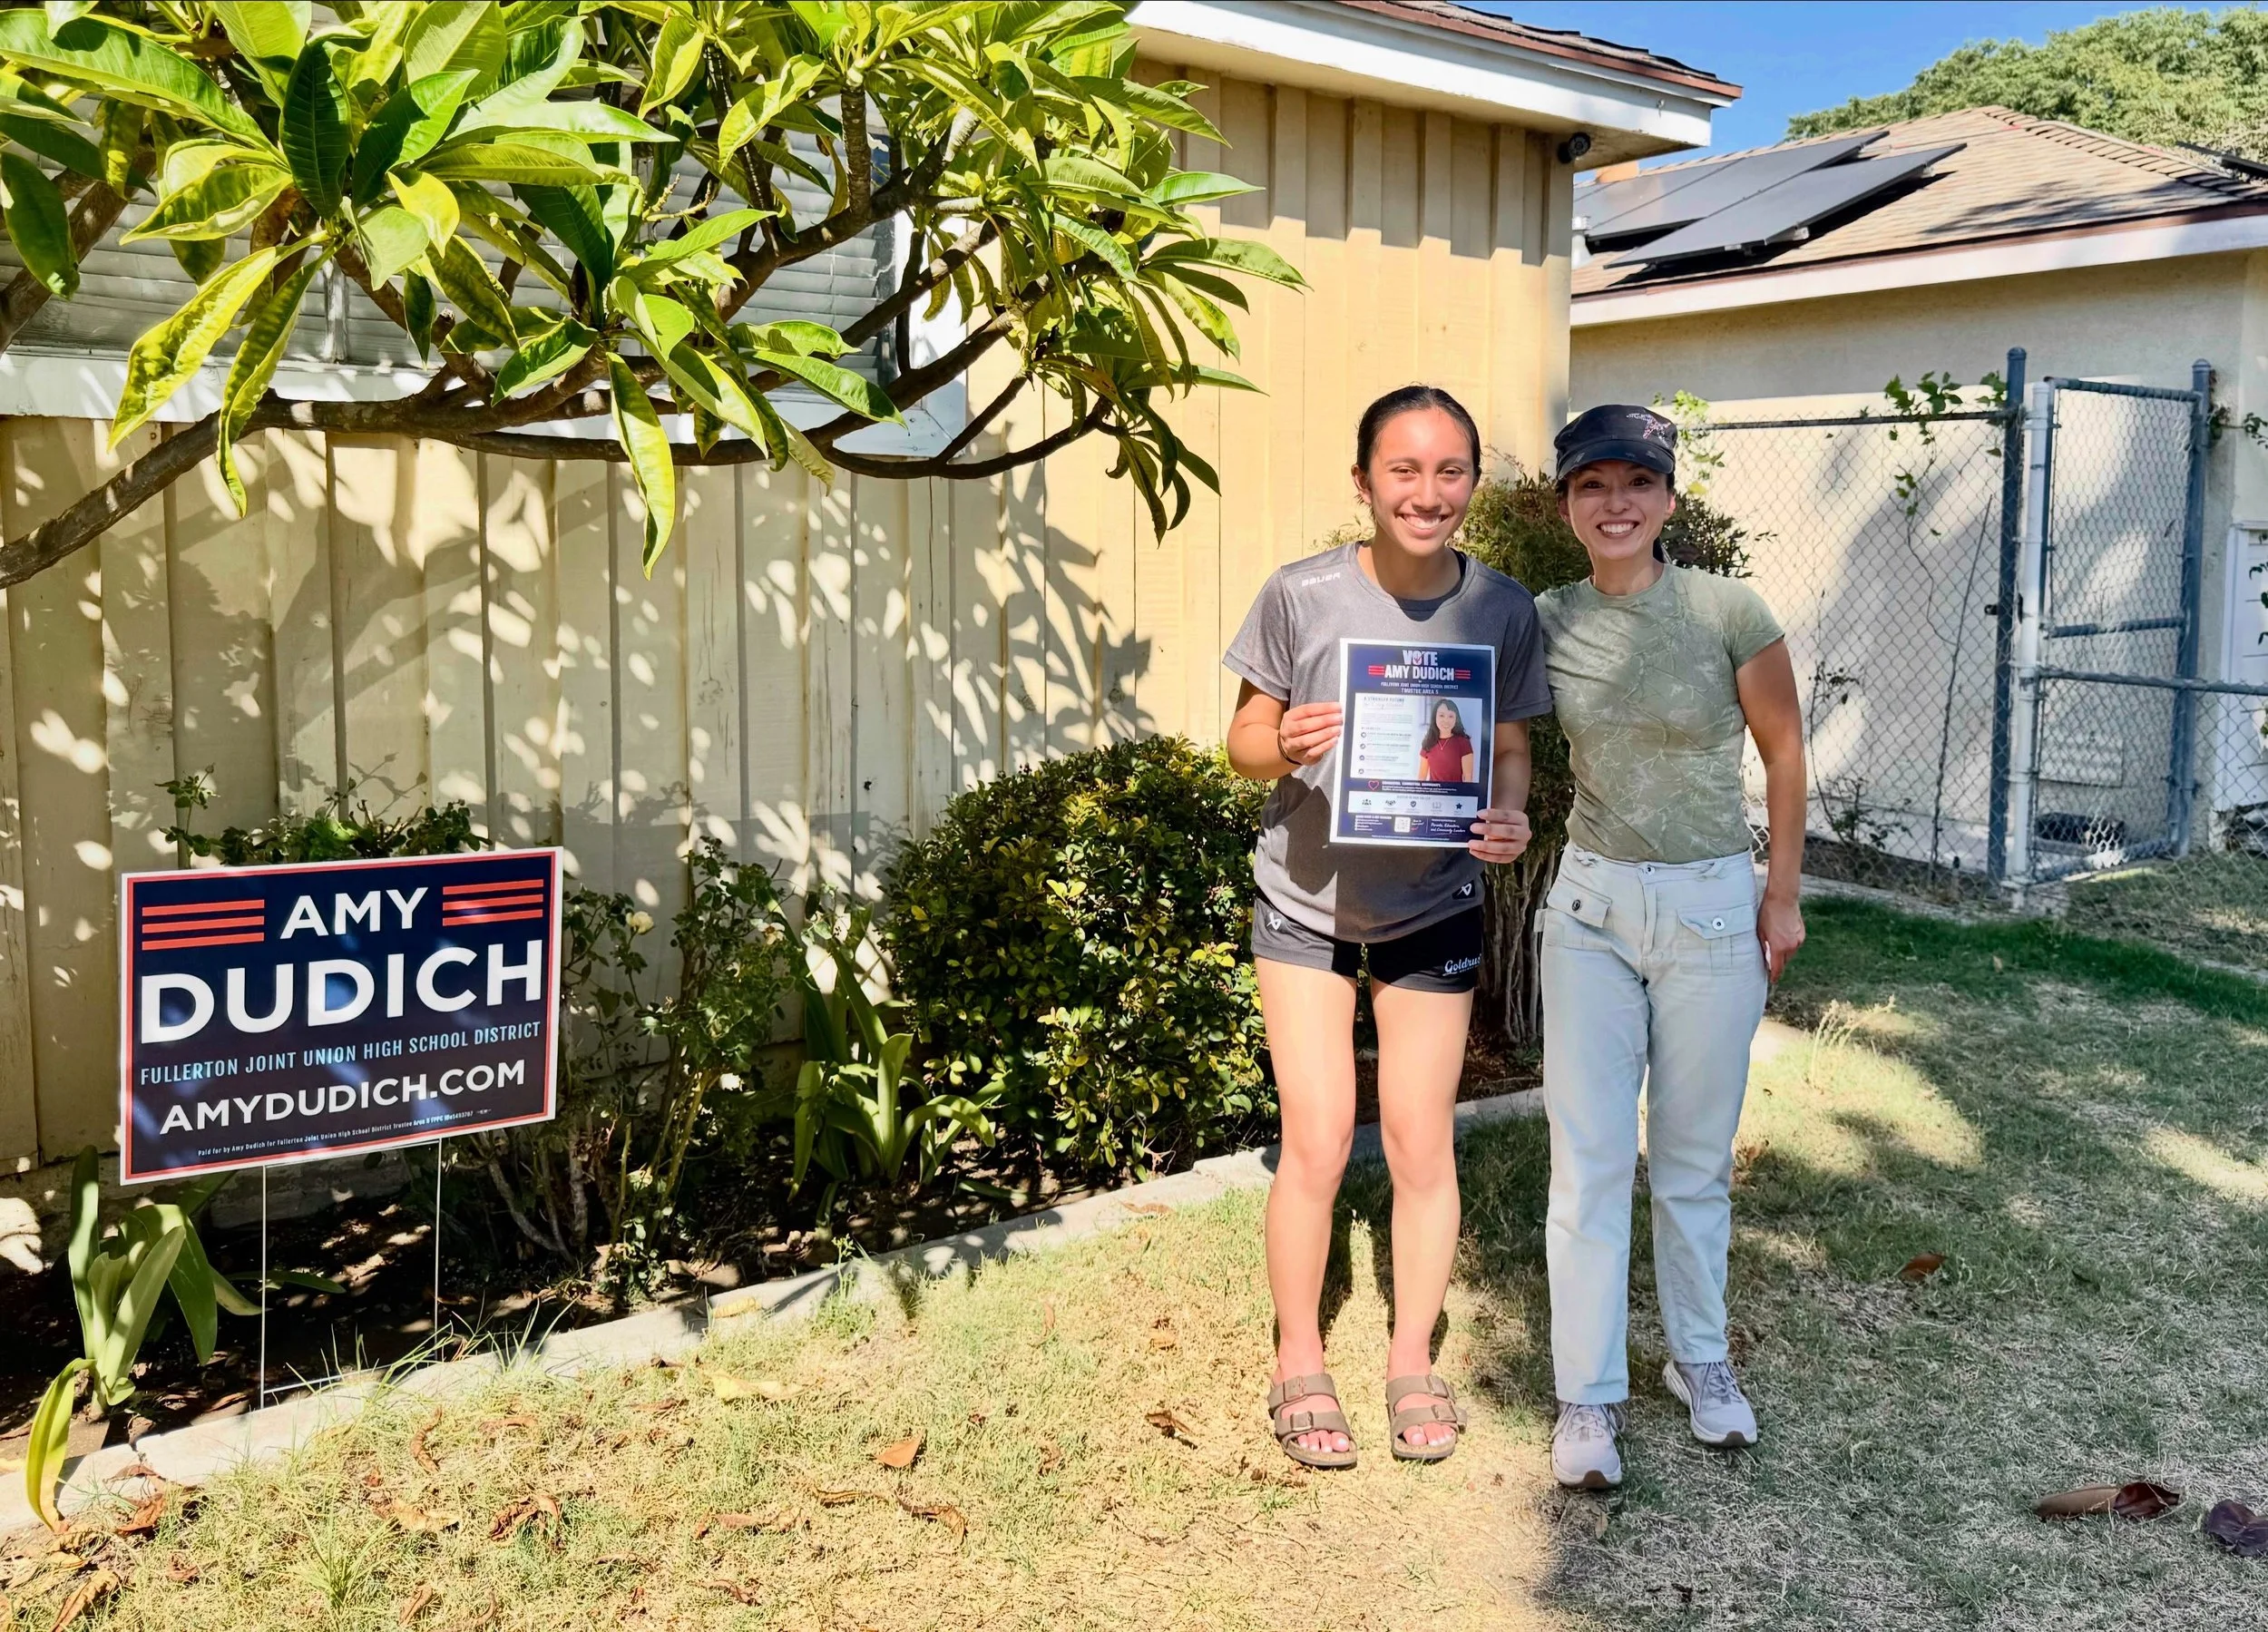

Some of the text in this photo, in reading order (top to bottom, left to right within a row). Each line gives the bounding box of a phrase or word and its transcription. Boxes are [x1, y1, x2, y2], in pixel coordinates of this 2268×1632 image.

[1384, 665, 1454, 680] AMY DUDICH
[1403, 650, 1438, 666] VOTE
[280, 887, 428, 939] AMY
[1442, 953, 1481, 976] Goldrus
[141, 940, 543, 1044] DUDICH
[141, 1021, 541, 1086] FULLERTON JOINT UNION HIGH SCHOOL DISTRICT
[160, 1060, 524, 1135] AMYDUDICH.COM
[198, 1148, 210, 1156] Paid
[223, 1146, 230, 1154] by
[231, 1144, 244, 1152] Amy
[246, 1141, 265, 1149] Dudich
[277, 1137, 303, 1146] Fullerton
[338, 1130, 351, 1138] High
[352, 1128, 370, 1136] School
[372, 1125, 392, 1133] District
[393, 1121, 412, 1129] Trustee
